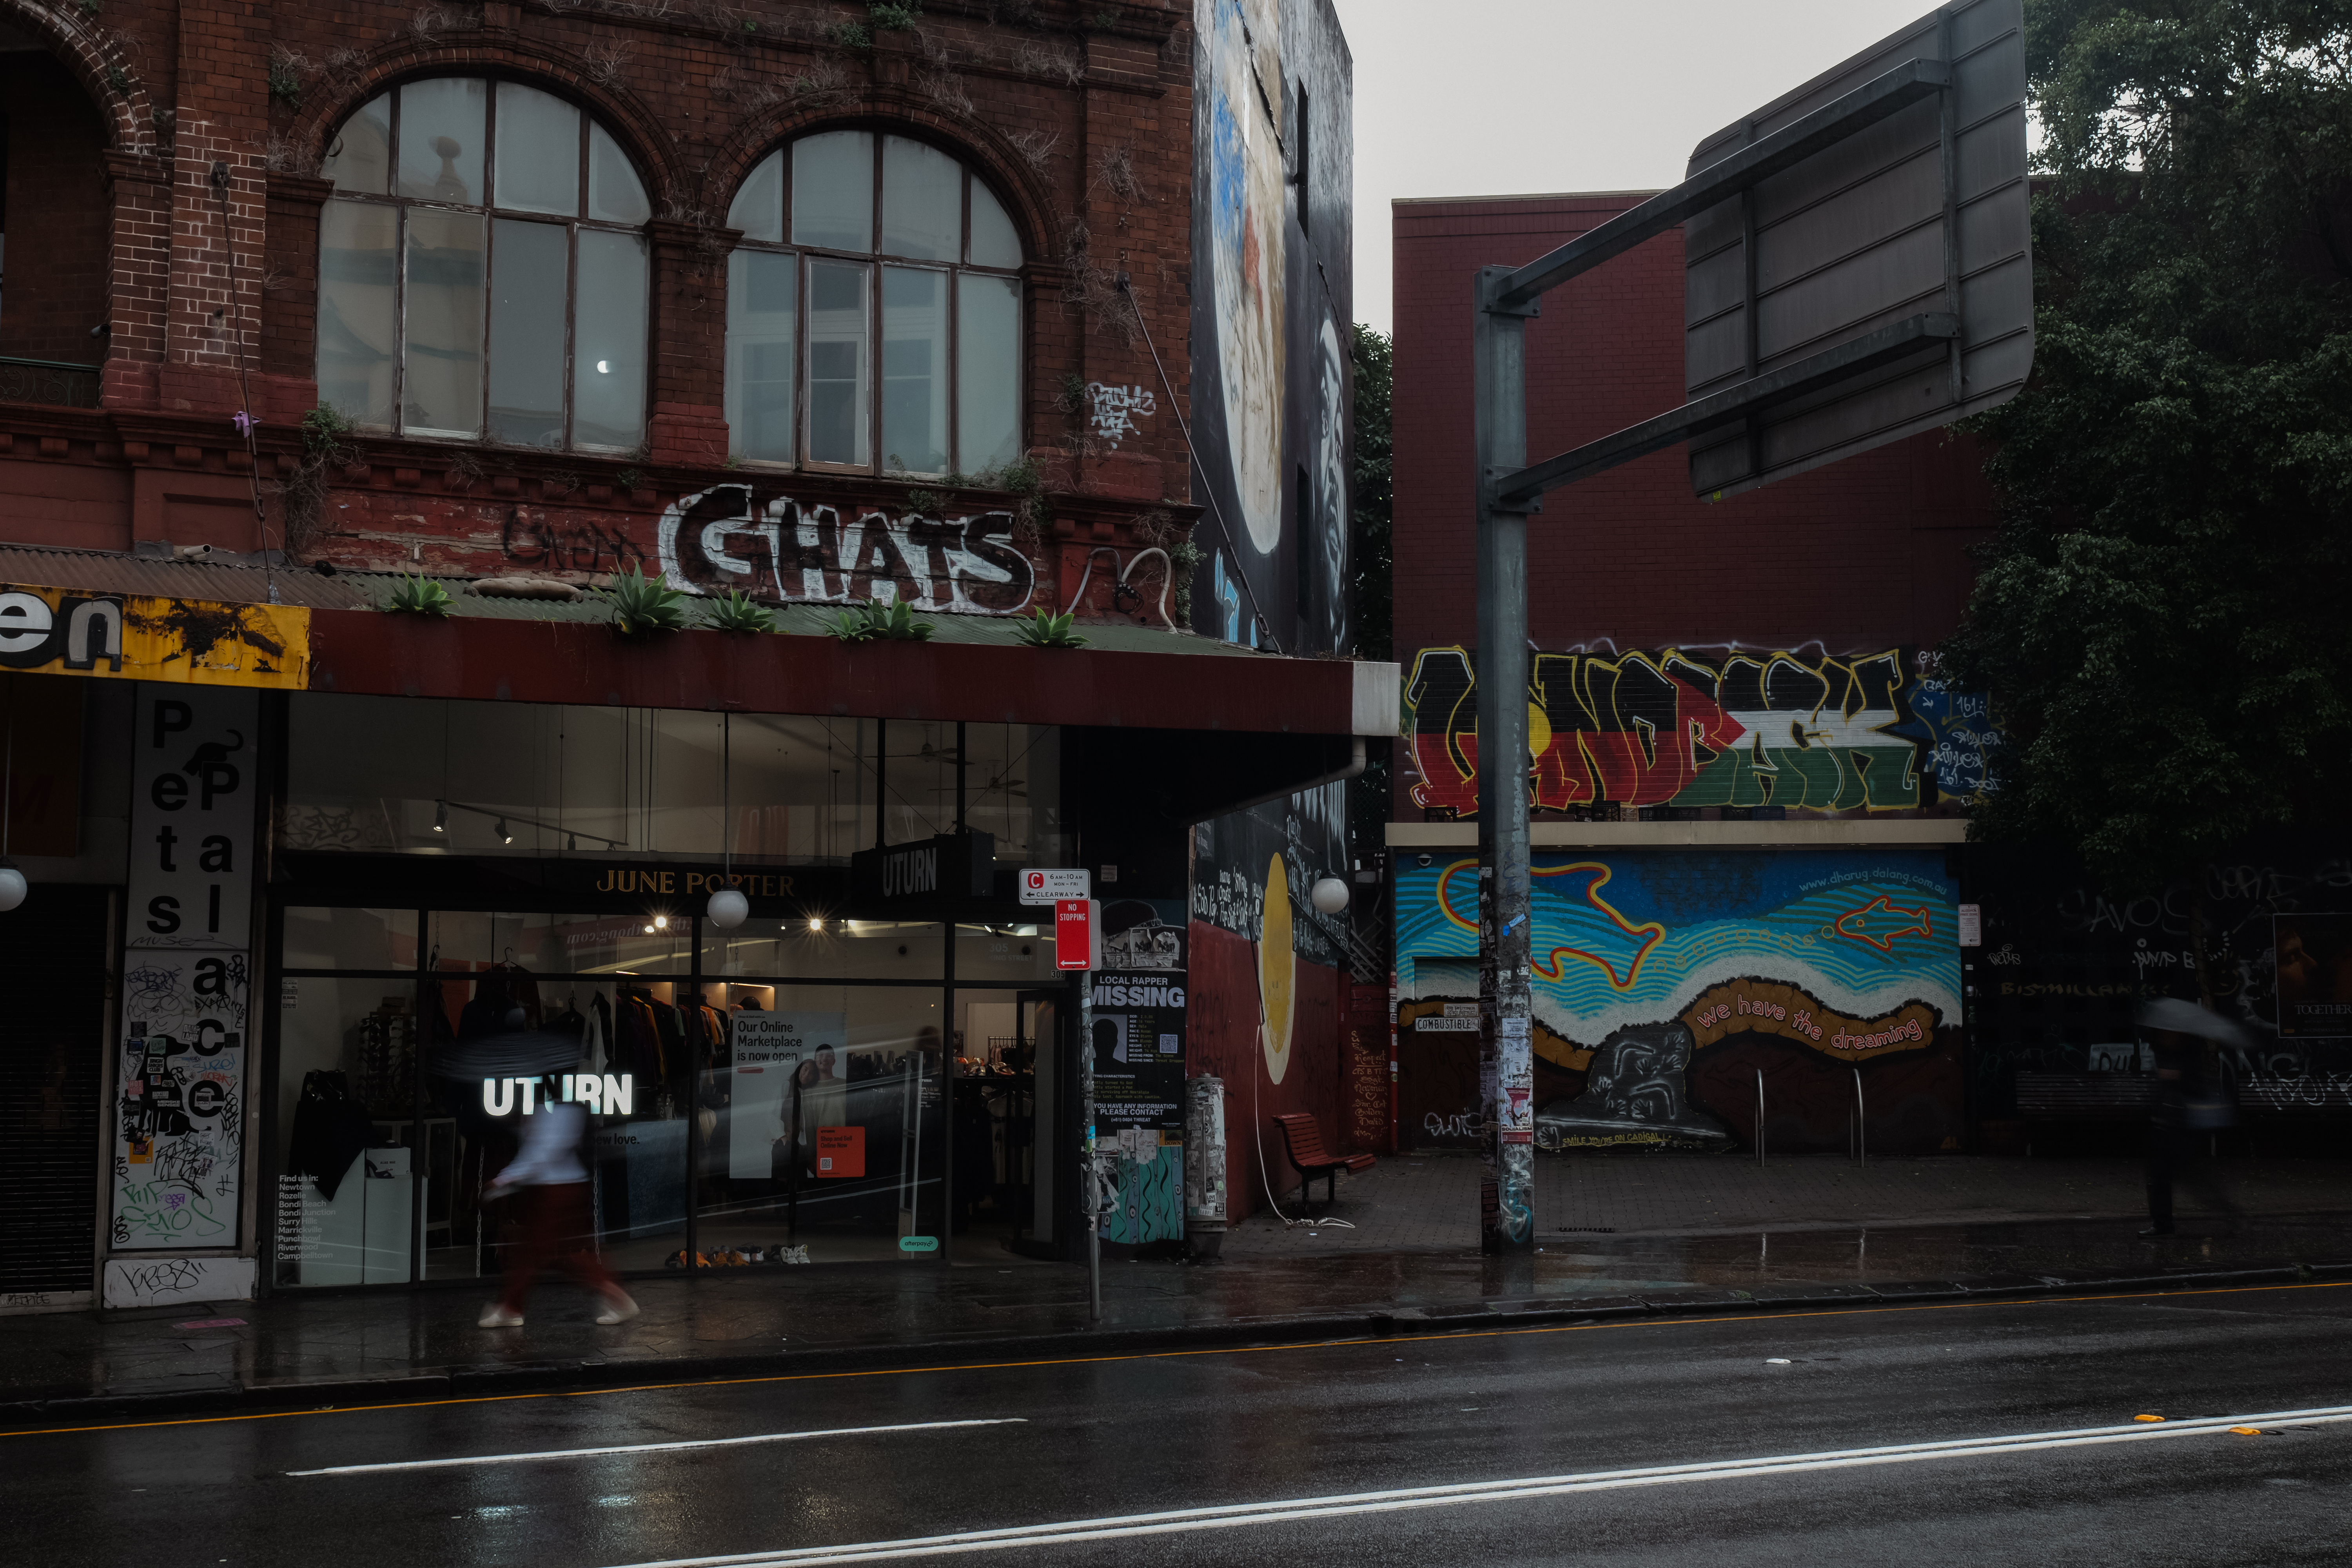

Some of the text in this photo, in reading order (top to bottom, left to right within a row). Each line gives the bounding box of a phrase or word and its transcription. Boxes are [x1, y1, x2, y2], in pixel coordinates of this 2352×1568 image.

[882, 847, 937, 897] UTURN
[597, 870, 796, 897] JUNE PORTER
[1031, 873, 1040, 887] C
[1800, 867, 1947, 895] www.dharug.dalang.com.au
[990, 943, 1008, 953] 305
[1100, 976, 1168, 985] LOCAL RAPPER
[1091, 985, 1185, 1007] MISSING
[2294, 1004, 2352, 1014] TOGETHER
[738, 1021, 793, 1033] Our Online
[1418, 1020, 1471, 1029] COMBUSTIBLE
[1697, 993, 1923, 1052] we have the dreaming
[738, 1035, 802, 1049] Marketplace
[738, 1049, 797, 1063] is now open
[614, 1133, 640, 1145] love.
[1563, 1134, 1586, 1145] SMILE
[120, 1181, 168, 1204] RIP
[278, 1252, 333, 1260] Campbelltown
